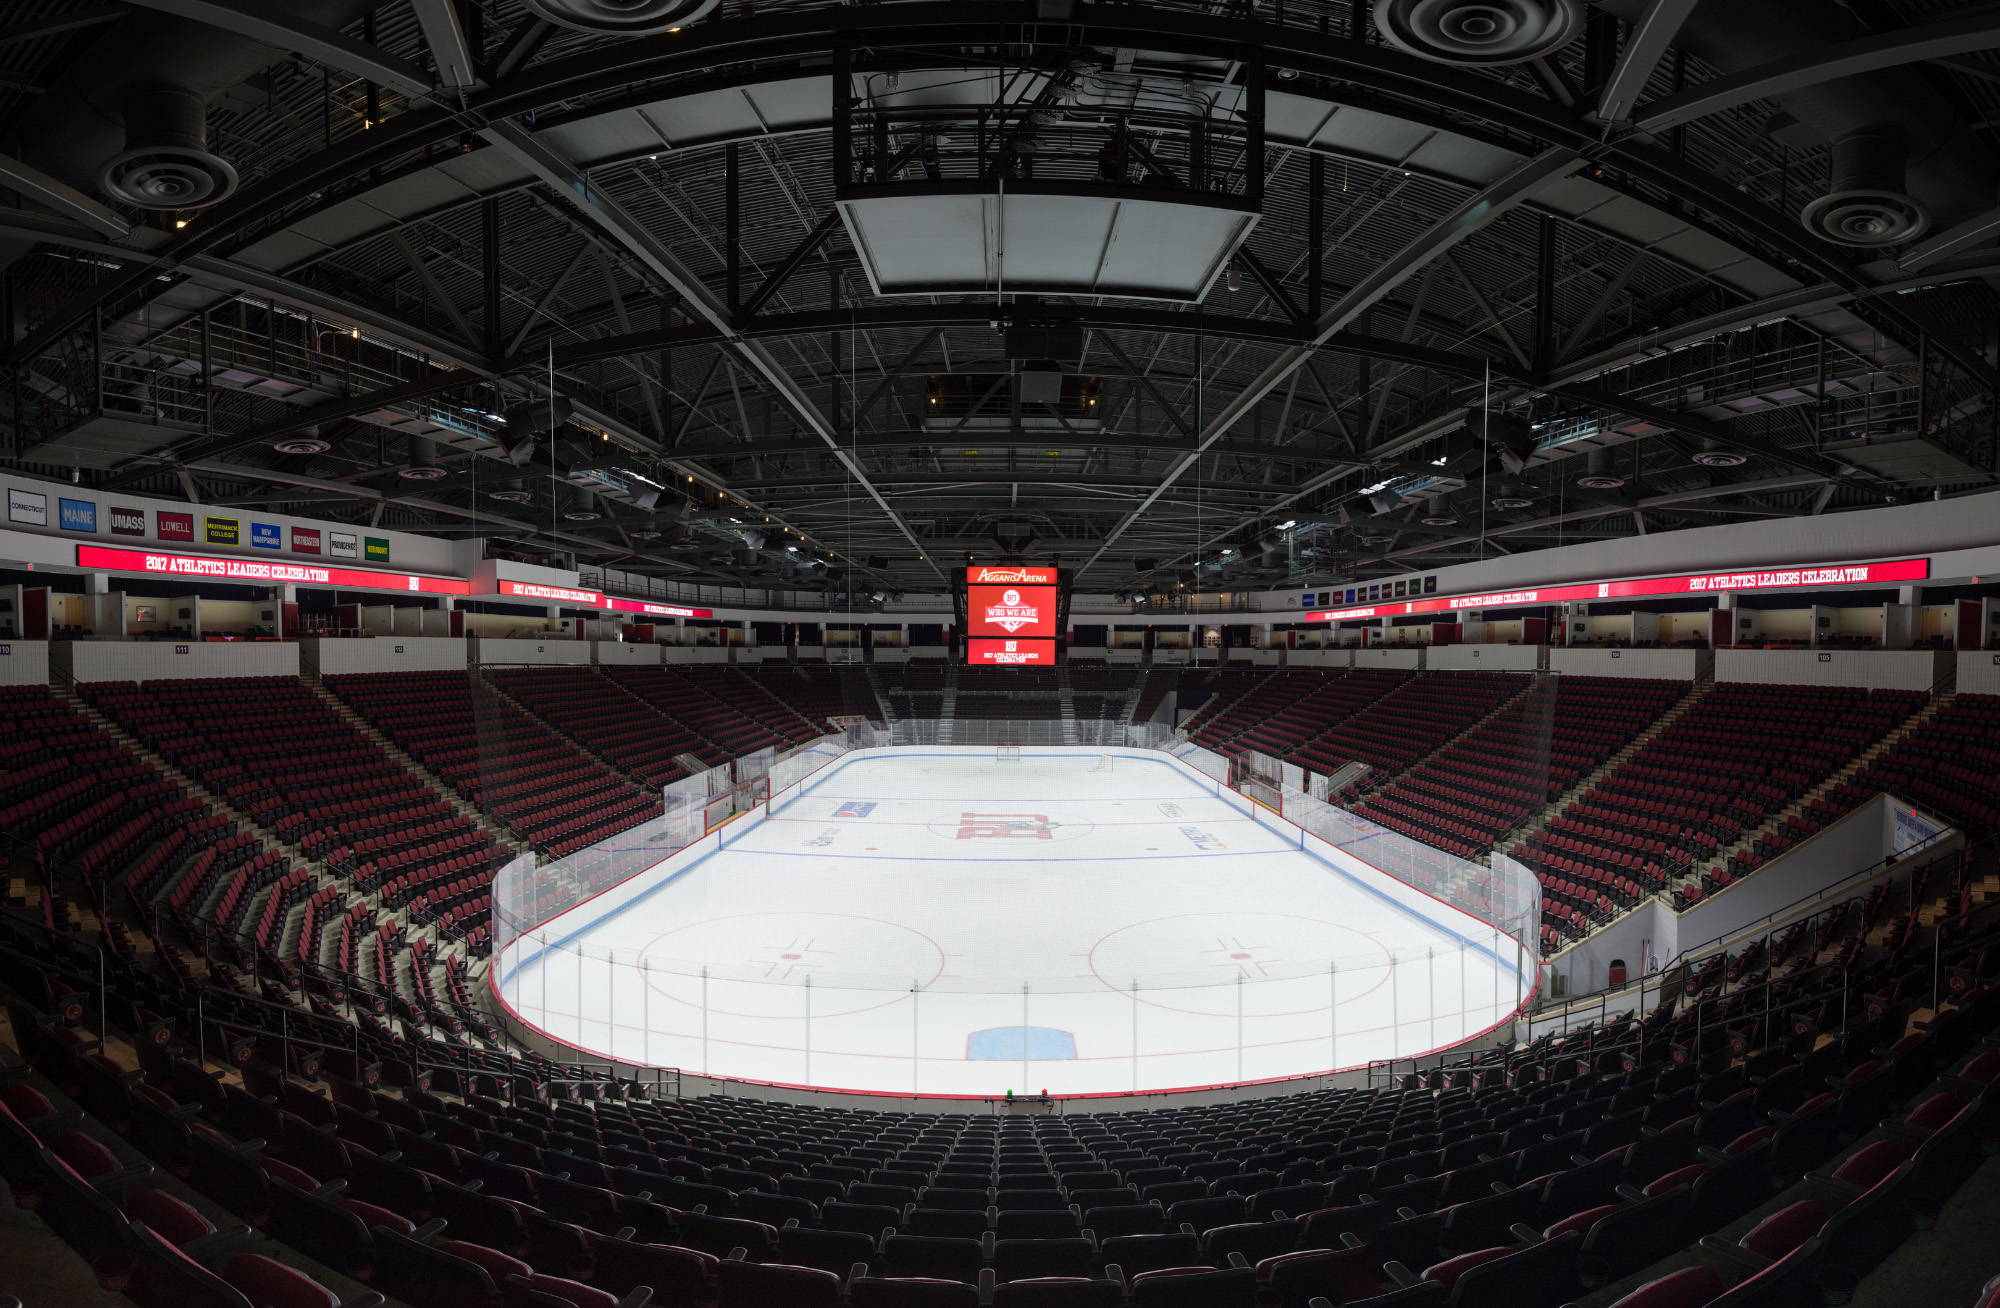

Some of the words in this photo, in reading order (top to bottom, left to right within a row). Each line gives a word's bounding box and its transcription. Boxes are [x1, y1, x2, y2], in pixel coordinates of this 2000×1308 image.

[12, 502, 45, 514] CONNECTICUT
[63, 507, 94, 525] MAINE
[111, 513, 145, 530] UMASS
[160, 521, 191, 533] LOWELL
[207, 523, 238, 532] MERRIMACK
[261, 528, 272, 536] NEW
[210, 530, 235, 539] COLLEGE
[252, 535, 281, 546] HAMPSHIRE
[331, 540, 356, 551] PROVIDENCE
[146, 556, 167, 571] 2017
[170, 558, 225, 575] ATHLETICS
[227, 563, 270, 578] LEADERS
[272, 566, 329, 582] CELEBRATION
[1689, 577, 1706, 590] 2017
[1708, 574, 1756, 589] ATHLETICS
[1757, 571, 1800, 586] LEADERS
[1801, 567, 1868, 584] CELEBRATION
[987, 608, 1005, 616] WHO
[1006, 608, 1019, 616] WE
[1020, 608, 1036, 617] ARE
[1005, 641, 1017, 652] BU
